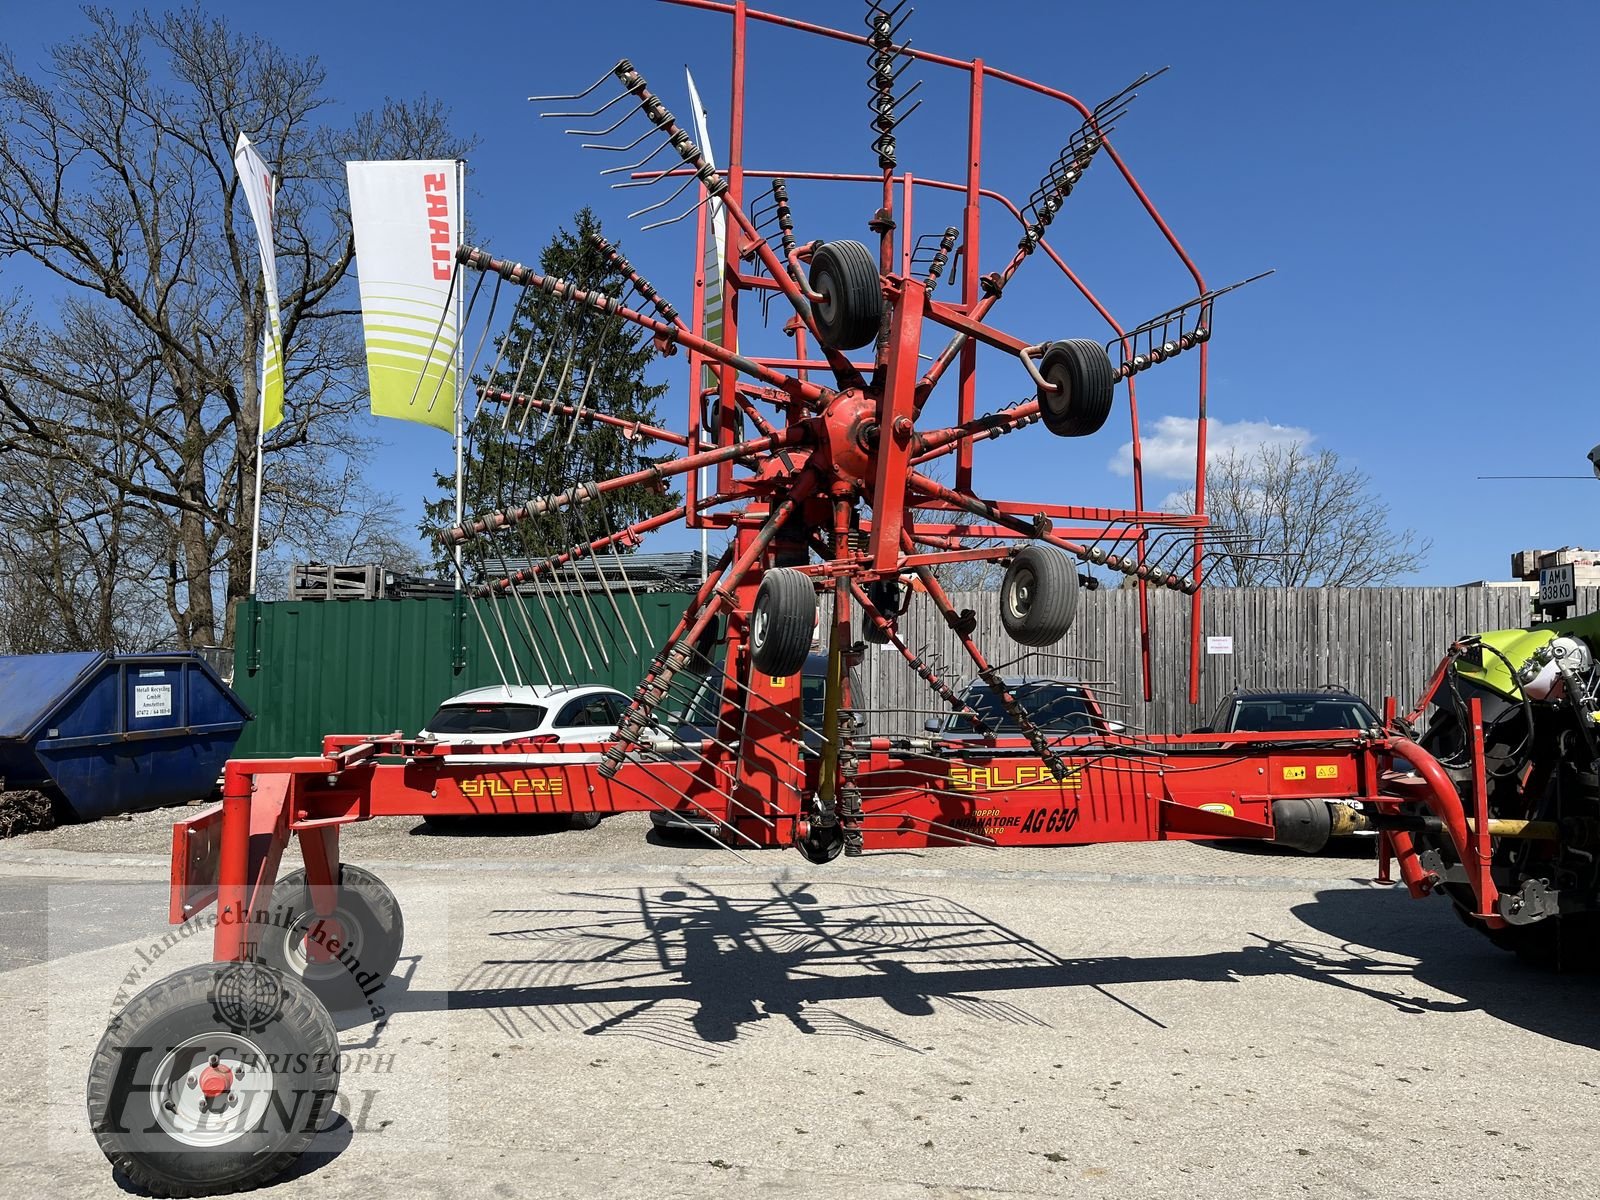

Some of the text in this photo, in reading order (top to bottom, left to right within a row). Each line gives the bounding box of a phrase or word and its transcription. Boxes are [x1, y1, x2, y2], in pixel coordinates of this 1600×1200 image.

[1548, 569, 1561, 585] AM
[1542, 583, 1570, 600] 338 KD
[948, 807, 1079, 834] ANDANATORE AG 650
[971, 809, 1000, 817] DOPPIO
